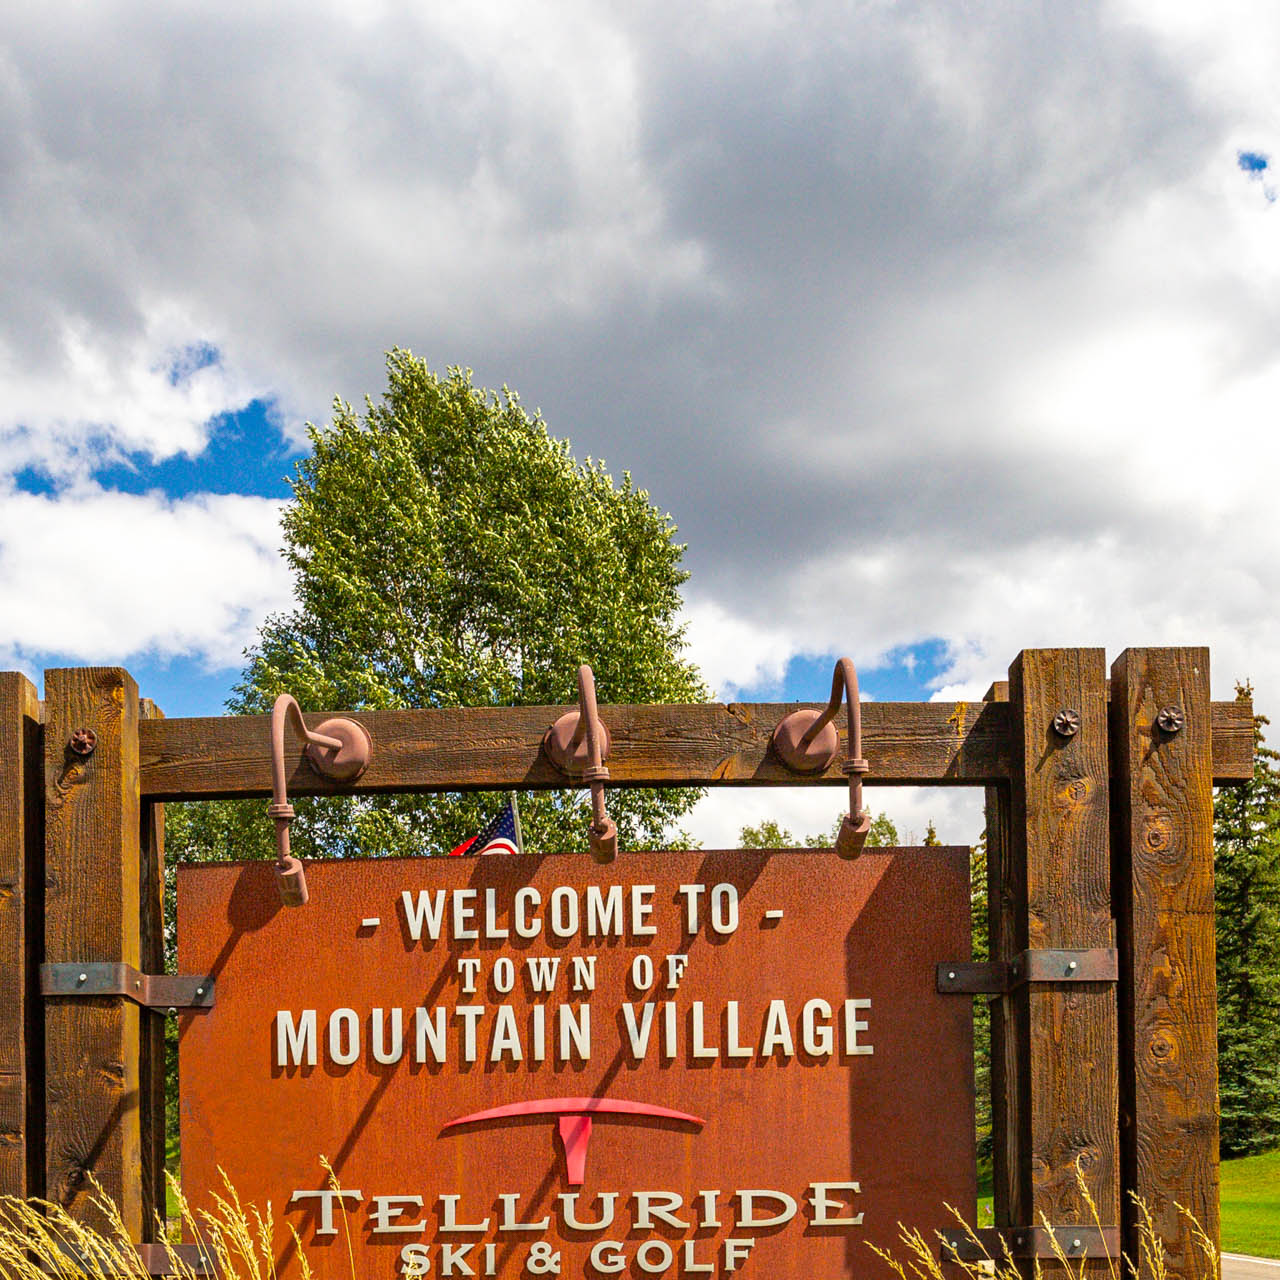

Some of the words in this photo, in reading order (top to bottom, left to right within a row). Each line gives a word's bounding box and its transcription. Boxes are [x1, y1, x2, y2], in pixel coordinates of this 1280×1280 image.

[402, 885, 657, 940] WELCOME
[680, 883, 740, 935] TO
[458, 956, 597, 993] TOWN
[633, 954, 688, 990] OF
[277, 1004, 590, 1066] MOUNTAIN
[622, 998, 874, 1058] VILLAGE
[290, 1182, 864, 1235] TELLURIDE
[400, 1243, 496, 1276] SKI
[527, 1242, 561, 1274] &
[591, 1238, 755, 1274] GOLF
